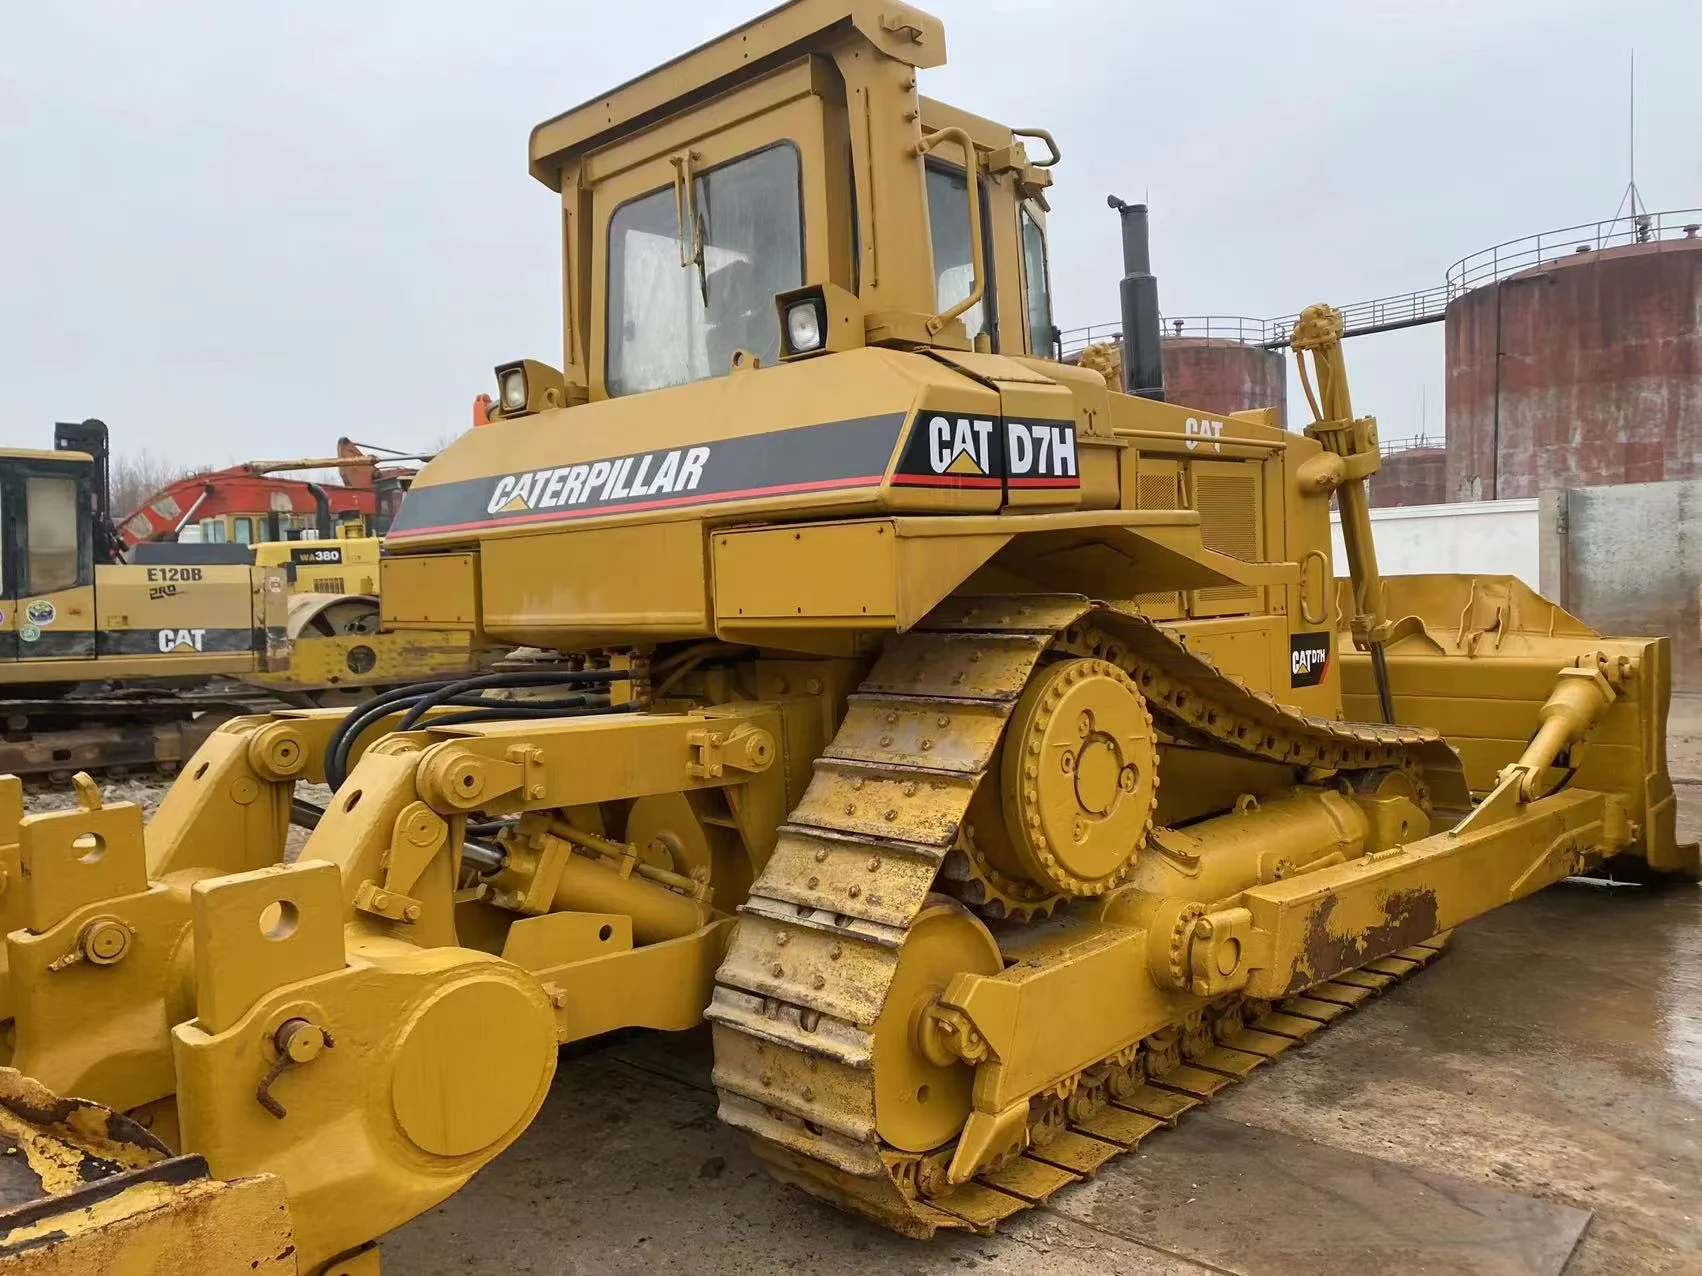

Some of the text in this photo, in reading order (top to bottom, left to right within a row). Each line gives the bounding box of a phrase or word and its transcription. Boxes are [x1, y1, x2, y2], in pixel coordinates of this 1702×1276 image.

[929, 416, 1076, 476] CAT D7H
[1185, 417, 1224, 453] CAT
[487, 446, 711, 514] CATERPILLAR
[147, 567, 203, 582] E120B
[159, 629, 206, 653] CAT
[1292, 648, 1326, 675] CAT D7H
